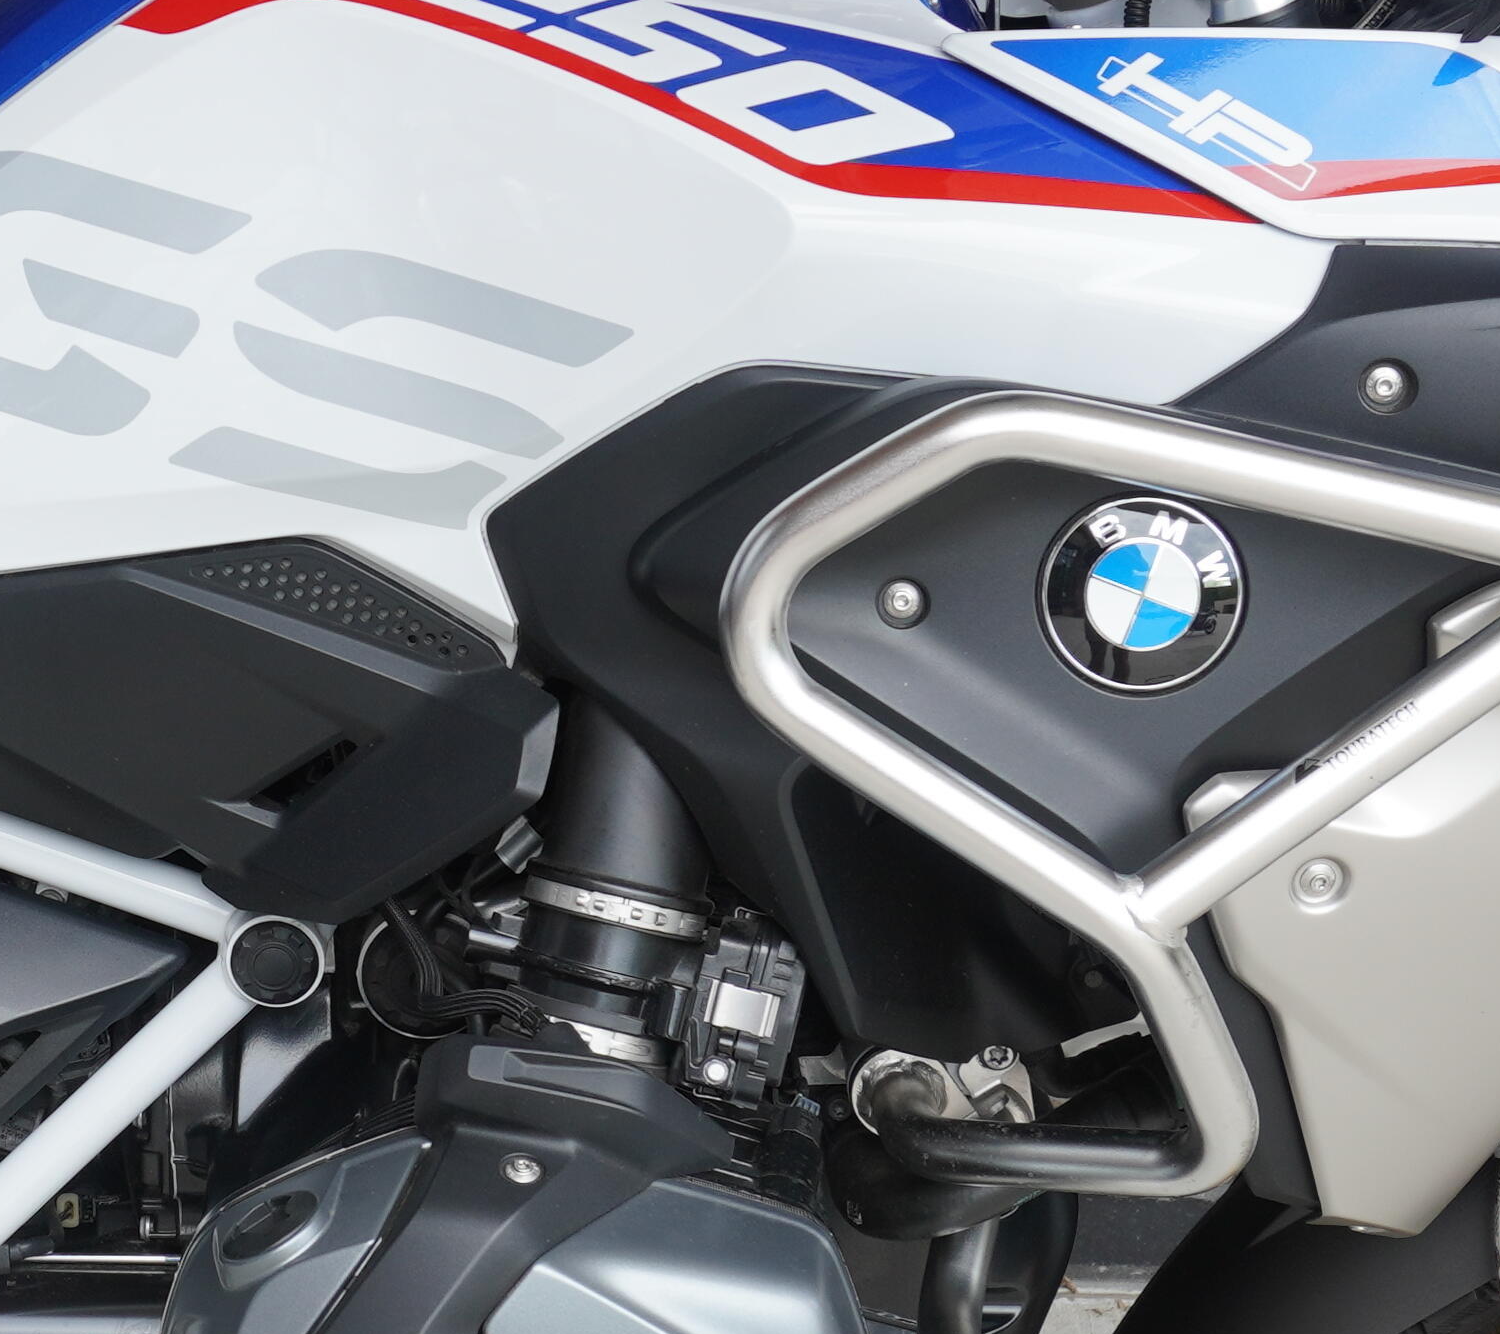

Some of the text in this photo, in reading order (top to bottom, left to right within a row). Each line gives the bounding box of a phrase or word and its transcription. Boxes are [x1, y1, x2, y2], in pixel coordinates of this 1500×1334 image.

[1096, 51, 1317, 192] HP
[1089, 510, 1231, 589] BMW
[1325, 699, 1420, 771] TOURATECH
